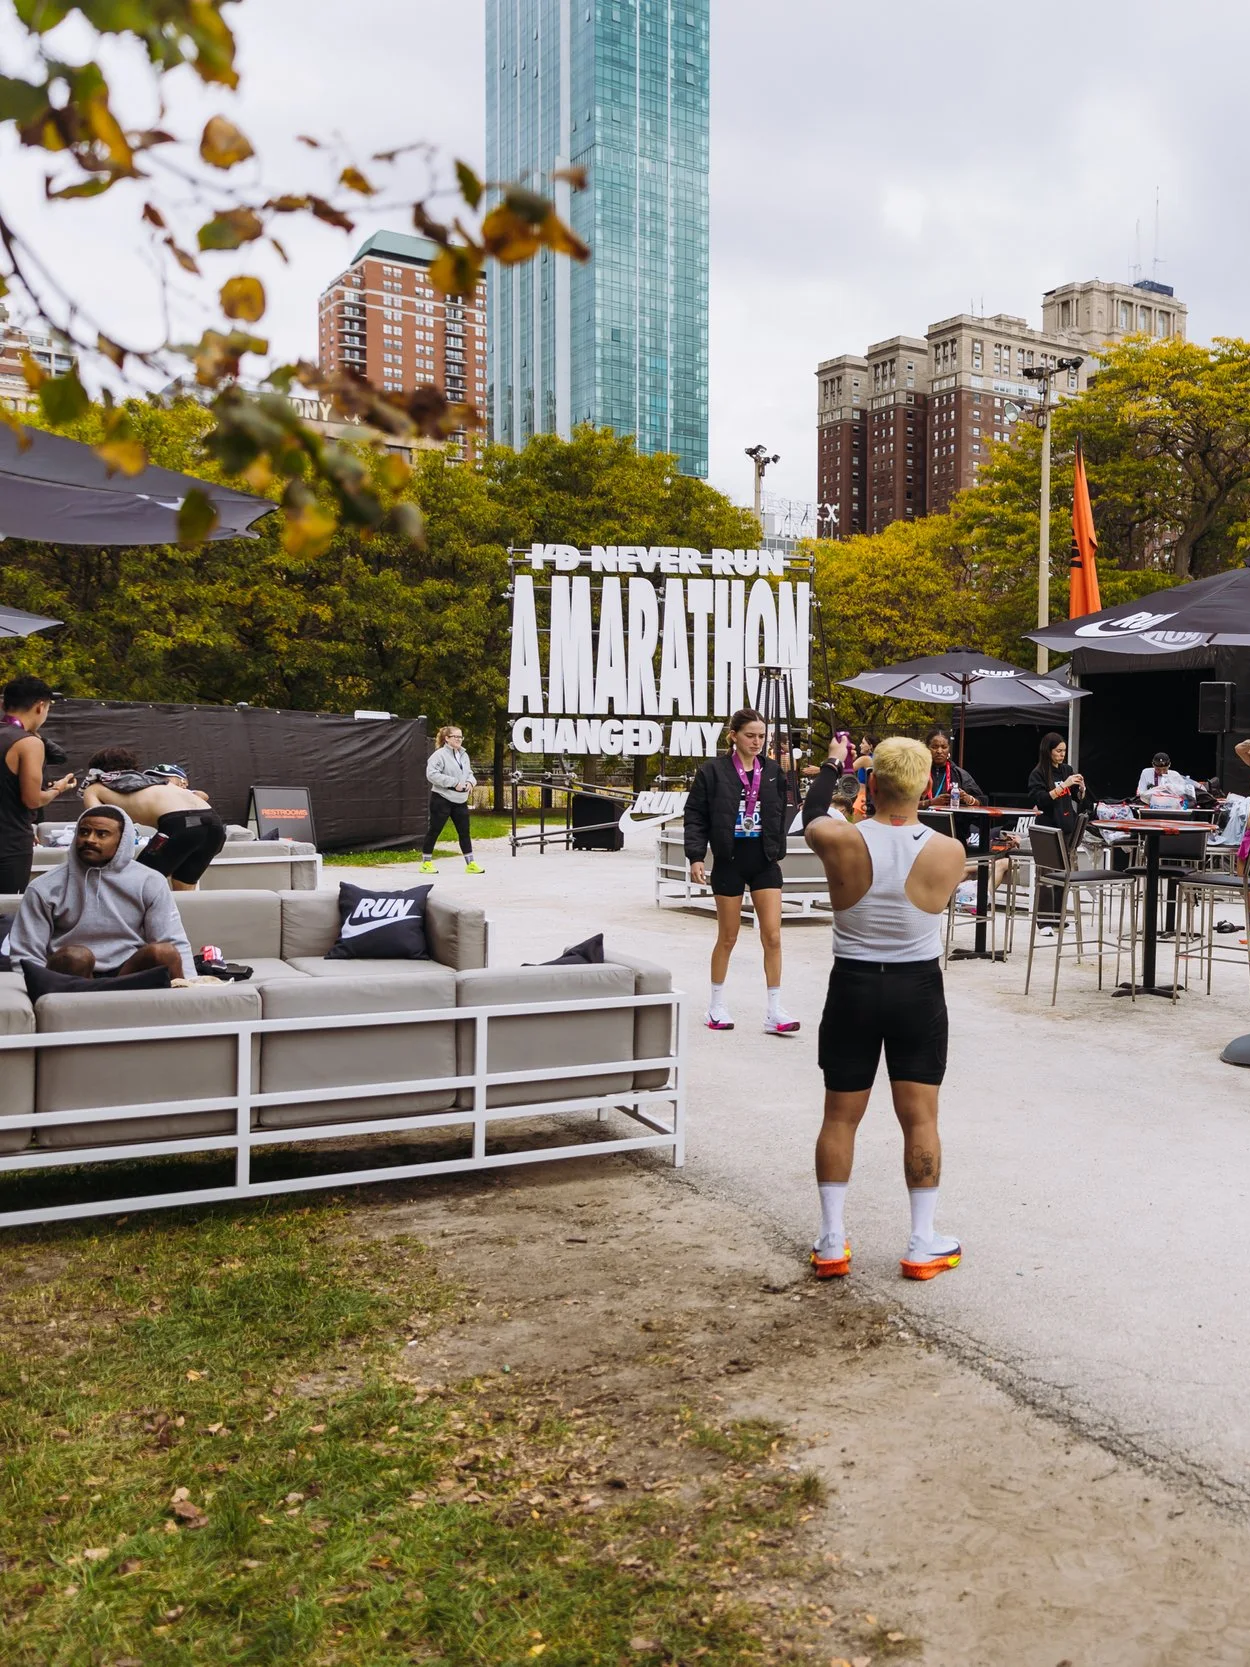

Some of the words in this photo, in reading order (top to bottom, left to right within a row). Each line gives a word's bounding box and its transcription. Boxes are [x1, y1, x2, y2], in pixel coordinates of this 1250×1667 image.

[591, 545, 703, 575] NEVER
[712, 549, 784, 576] RUN
[508, 575, 543, 713] A
[548, 576, 809, 718] MARATHON
[512, 717, 663, 755] CHANGED
[669, 721, 724, 756] MY
[632, 791, 690, 814] RUN
[352, 898, 415, 918] RUN
